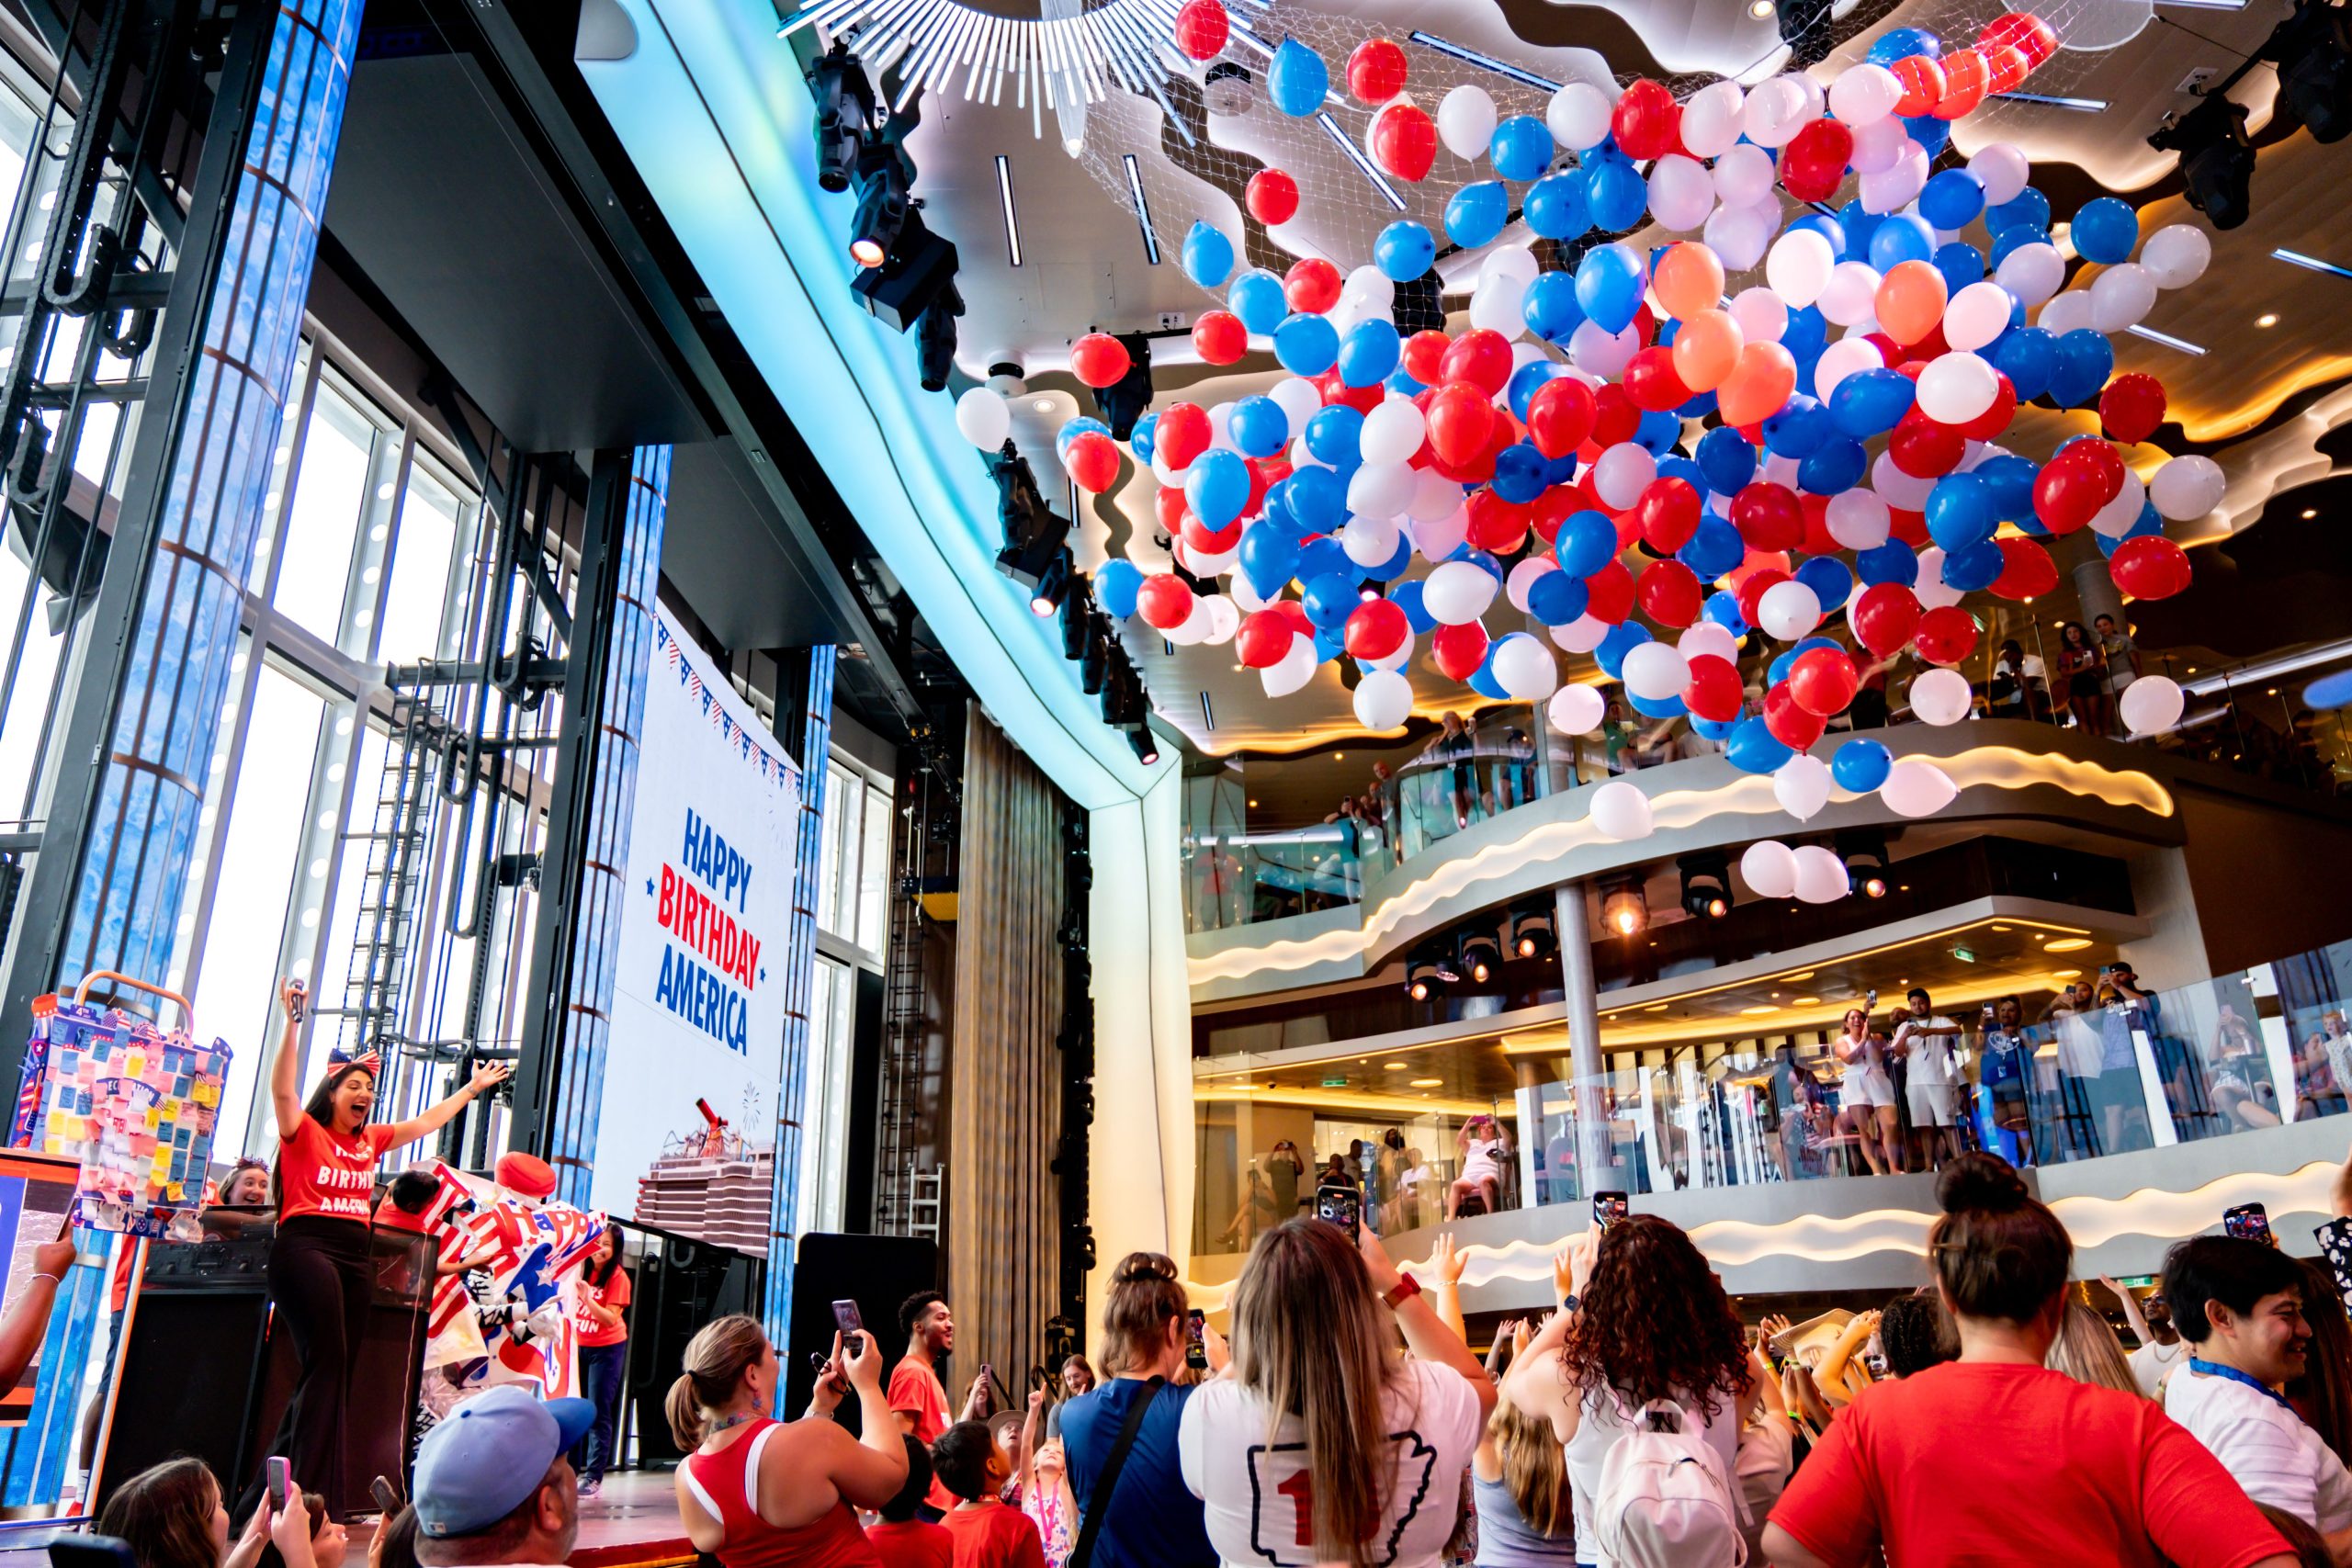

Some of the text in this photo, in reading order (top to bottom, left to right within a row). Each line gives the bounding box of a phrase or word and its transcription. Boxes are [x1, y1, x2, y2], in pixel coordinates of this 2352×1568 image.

[683, 807, 752, 914] HAPPY
[657, 862, 761, 991] BIRTHDAY
[655, 943, 747, 1056] AMERICA
[575, 1320, 599, 1333] FUN
